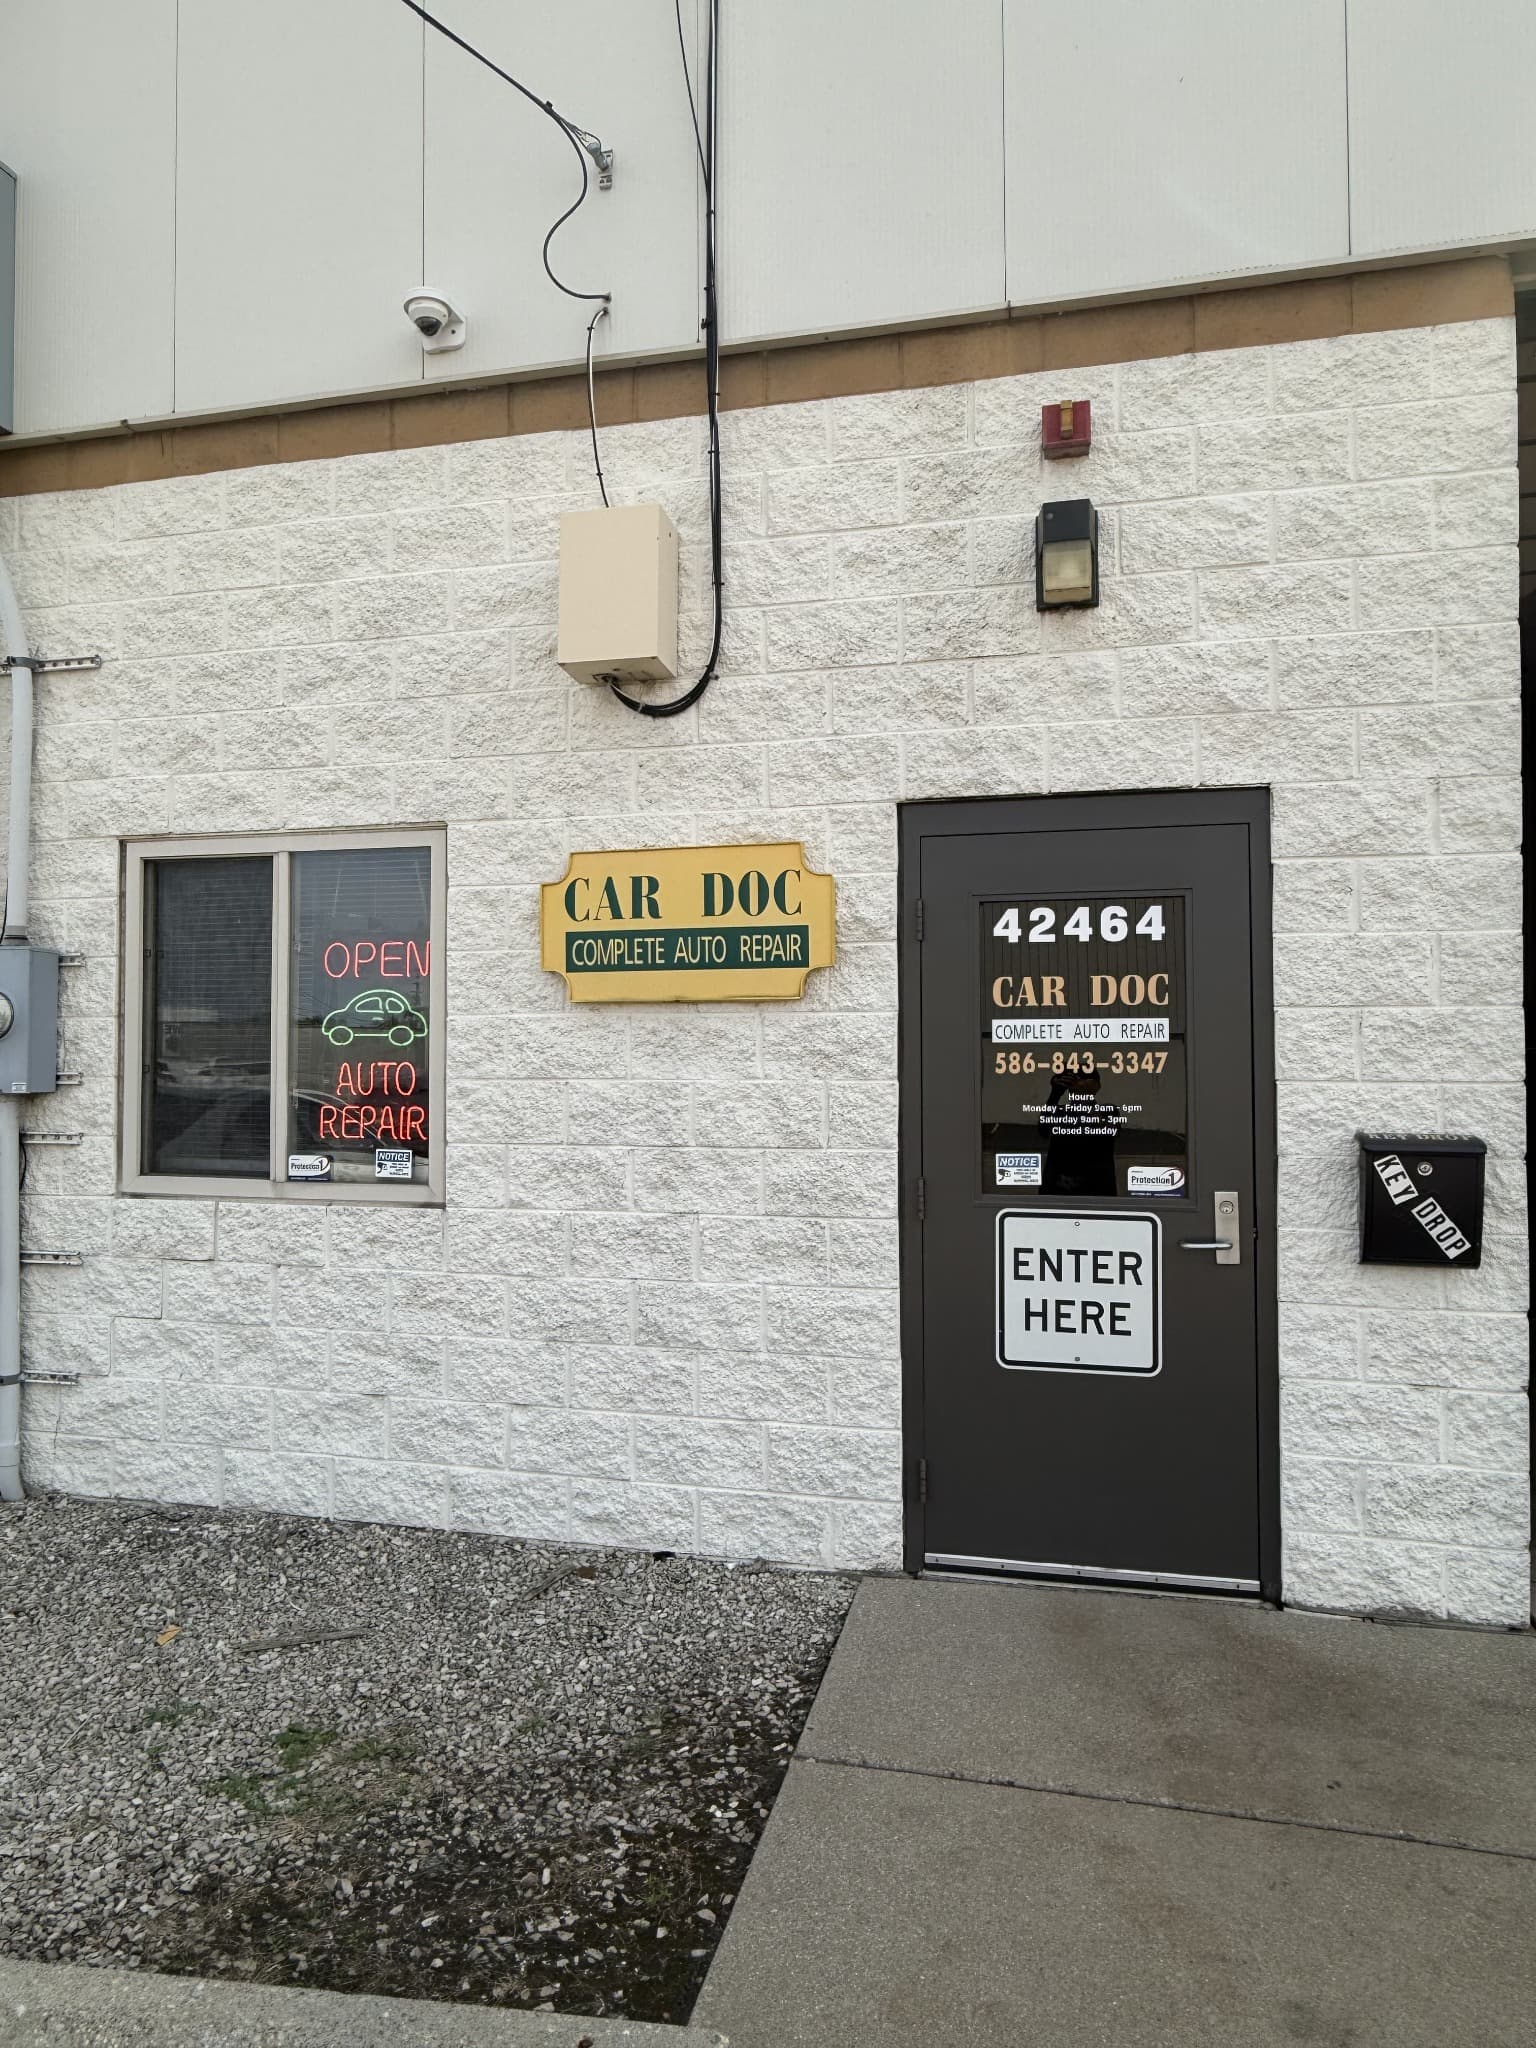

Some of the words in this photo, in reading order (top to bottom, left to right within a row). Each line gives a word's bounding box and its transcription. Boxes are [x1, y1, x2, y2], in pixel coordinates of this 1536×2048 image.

[564, 875, 662, 922] CAR
[701, 869, 801, 917] DOC
[993, 905, 1165, 943] 42464
[324, 940, 430, 978] OPEN
[572, 937, 665, 966] COMPLETE
[674, 935, 727, 964] AUTO
[740, 933, 802, 962] REPAIR
[992, 976, 1067, 1008] CAR
[1090, 973, 1169, 1006] DOC
[995, 1024, 1062, 1040] COMPLETE
[1073, 1023, 1110, 1039] AUTO
[1121, 1023, 1166, 1038] REPAIR
[337, 1061, 416, 1096] AUTO
[995, 1051, 1168, 1074] 586-843-3347
[1022, 1104, 1057, 1113] Monday
[1065, 1104, 1092, 1113] Friday
[1094, 1104, 1114, 1112] 9am
[1122, 1104, 1142, 1113] 6pm
[1068, 1093, 1094, 1101] Hours
[319, 1105, 428, 1141] REPAIR
[1039, 1115, 1078, 1125] Saturday
[1080, 1115, 1100, 1124] 9am
[1107, 1115, 1128, 1125] 3pm
[1052, 1126, 1082, 1135] Closed
[1084, 1126, 1118, 1136] Sunday
[378, 1152, 409, 1161] NOTICE
[999, 1157, 1037, 1167] NOTICE
[1376, 1156, 1416, 1199] KEY
[1415, 1201, 1467, 1252] DROP
[1013, 1247, 1143, 1286] ENTER
[1024, 1298, 1132, 1337] HERE
